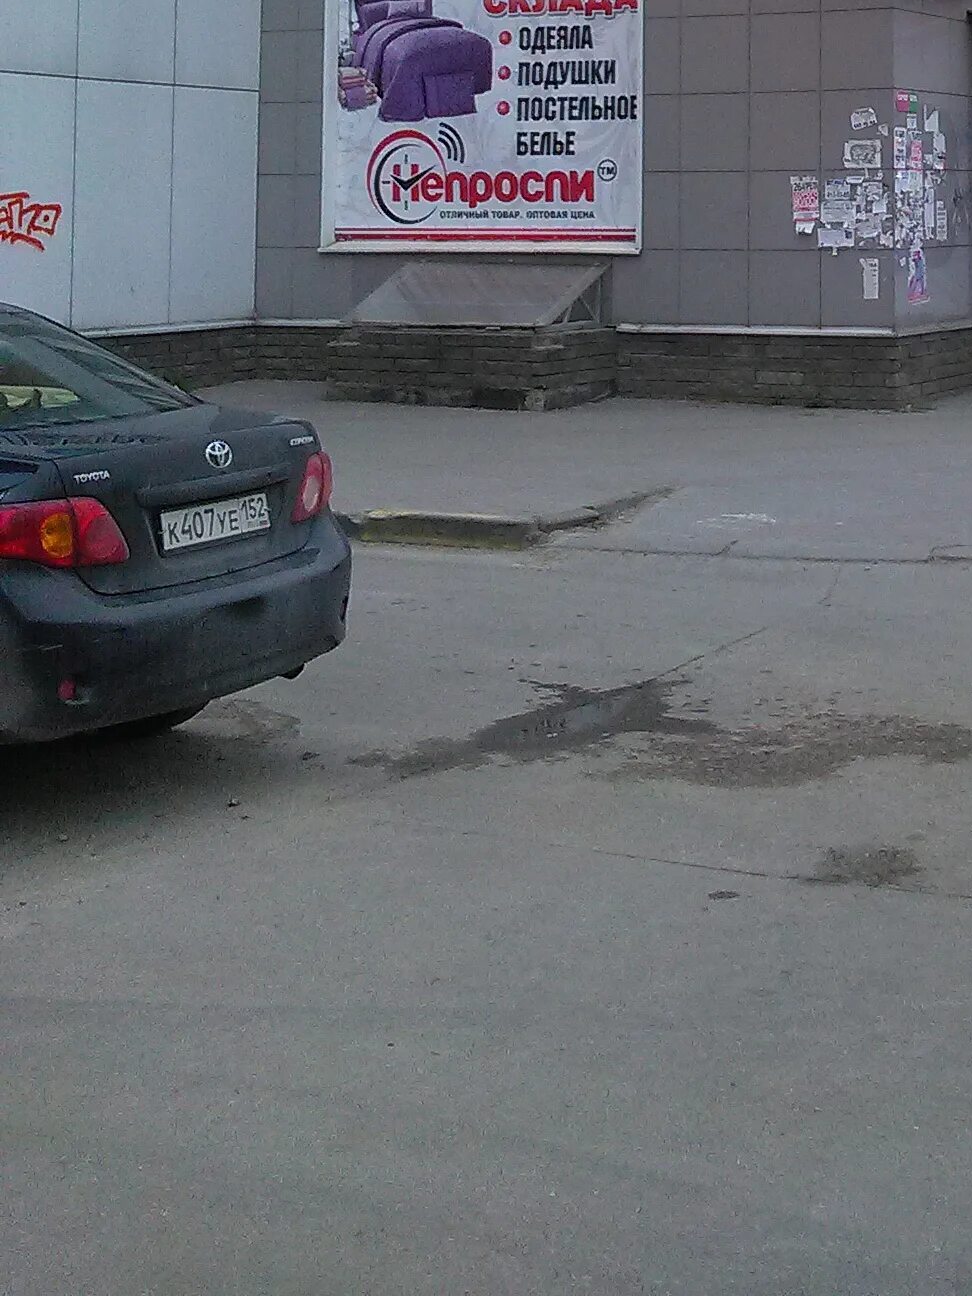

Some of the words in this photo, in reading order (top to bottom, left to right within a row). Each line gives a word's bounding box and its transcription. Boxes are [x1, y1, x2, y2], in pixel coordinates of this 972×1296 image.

[518, 25, 593, 54] ОДЕЯЛА
[517, 60, 616, 90] ПОДУШКИ
[516, 95, 638, 122] ПОСТЕЛЬНОЕ
[516, 131, 576, 156] БЕЛЬЕ
[439, 210, 490, 220] ОТЛИЧНЫЙ
[526, 210, 568, 220] ОПТОВАЯ
[570, 210, 595, 220] ЦЕНА
[73, 470, 110, 485] TOYOTA
